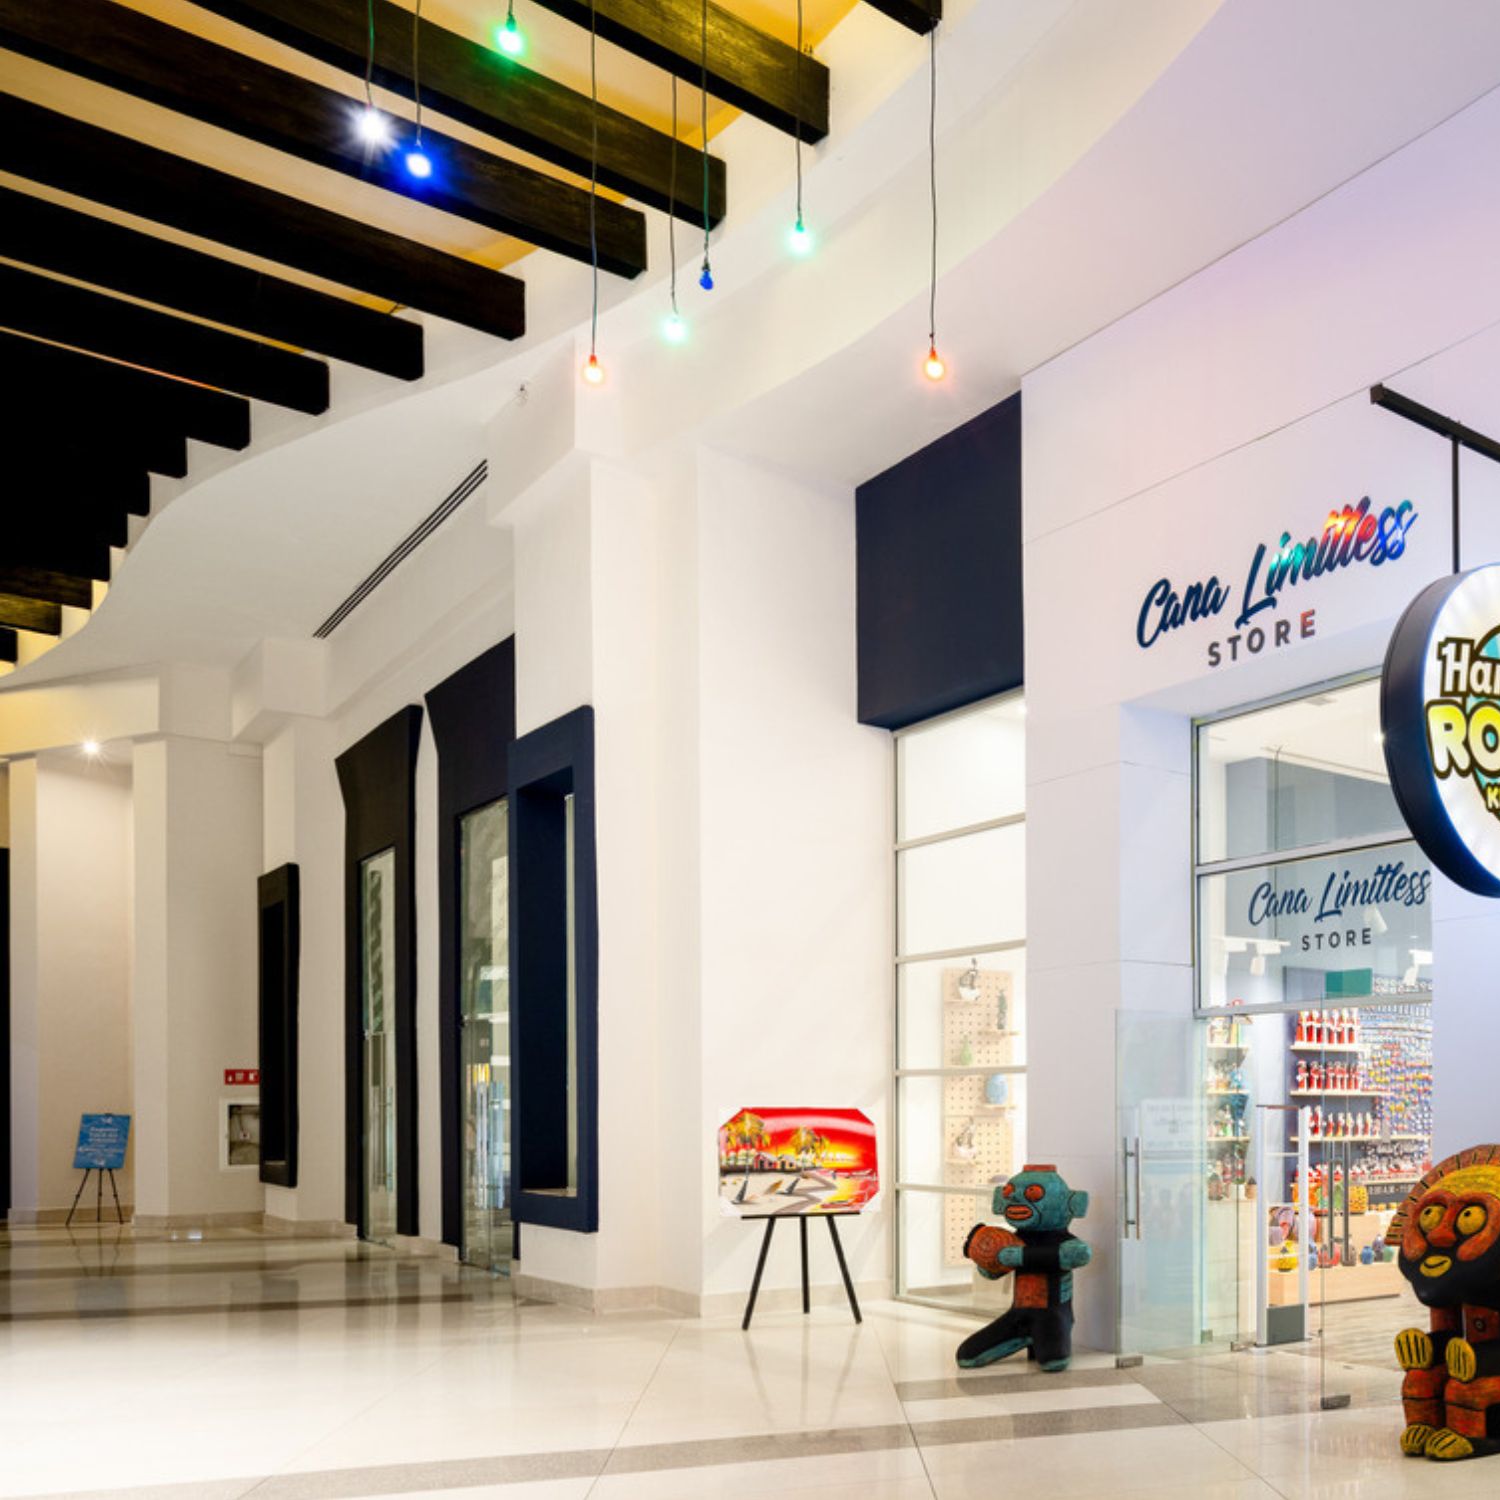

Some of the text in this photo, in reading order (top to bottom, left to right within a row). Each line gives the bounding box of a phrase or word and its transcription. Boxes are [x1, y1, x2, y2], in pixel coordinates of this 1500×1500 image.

[1137, 495, 1418, 648] Cana Limitless
[1208, 609, 1315, 666] STORE
[1249, 861, 1431, 926] Cana Limitless
[1302, 928, 1372, 951] STORE
